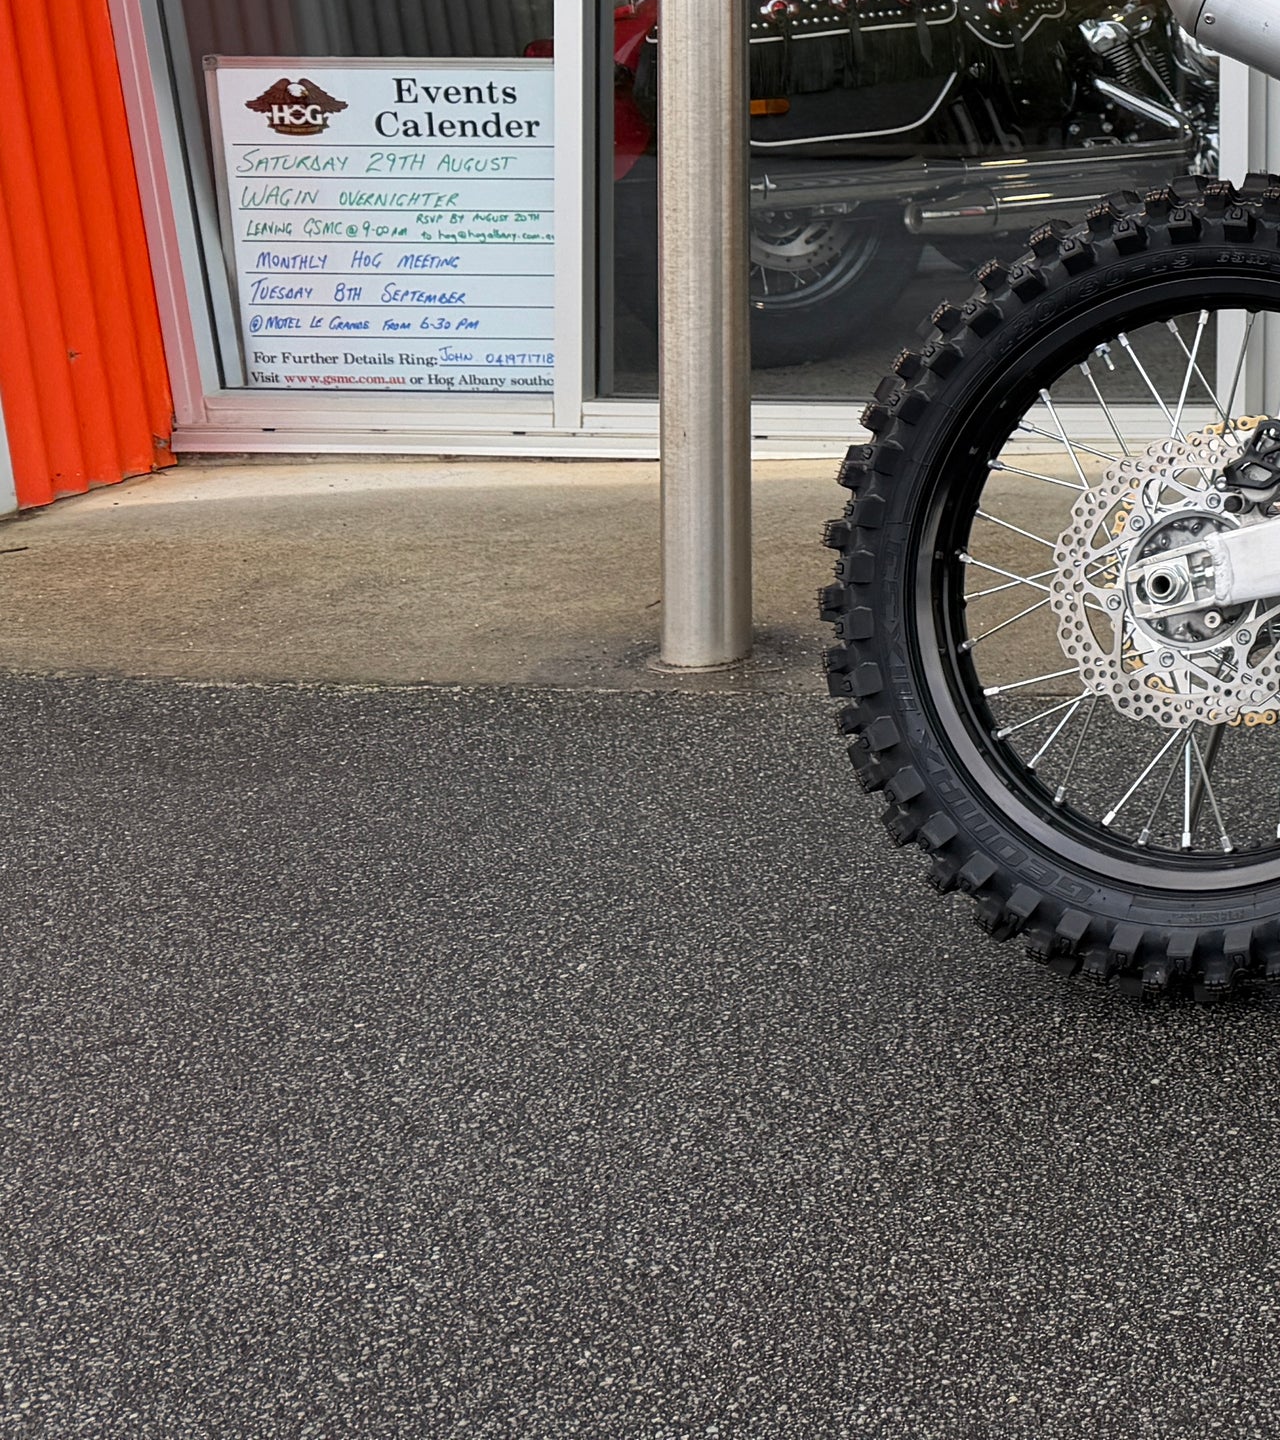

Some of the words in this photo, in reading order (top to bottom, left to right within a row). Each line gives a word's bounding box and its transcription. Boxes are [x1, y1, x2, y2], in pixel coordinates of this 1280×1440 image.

[392, 77, 518, 104] Events
[271, 104, 324, 125] HOG
[375, 111, 541, 138] Calender
[236, 148, 349, 173] SATURDAY
[365, 151, 426, 173] 29TH
[437, 153, 518, 173] AUGUST
[241, 184, 320, 207] WAGIN
[339, 190, 460, 208] OVERNIGHTER
[246, 219, 292, 236] LEAVING
[303, 217, 342, 238] GSMC
[416, 213, 443, 225] RSVP
[450, 213, 464, 224] BY
[472, 212, 509, 223] AUGUST
[256, 251, 327, 270] MONTHLY
[351, 249, 383, 269] HOG
[397, 253, 460, 269] MEETING
[251, 277, 313, 302] TUESDAY
[334, 282, 362, 302] 8TH
[381, 282, 467, 305] SEPTEMBER
[264, 315, 301, 329] MOTEL
[309, 315, 324, 328] LE
[382, 318, 411, 331] FROM
[456, 317, 480, 330] PM
[253, 351, 278, 364] For
[281, 351, 339, 364] Further
[343, 352, 395, 365] Details
[398, 352, 438, 367] Ring:
[439, 345, 473, 362] JOHN
[251, 371, 279, 383] Visit
[284, 374, 405, 386] www.gsmc.com.au
[409, 376, 423, 385] or
[428, 374, 454, 388] Hog
[458, 374, 506, 388] Albany
